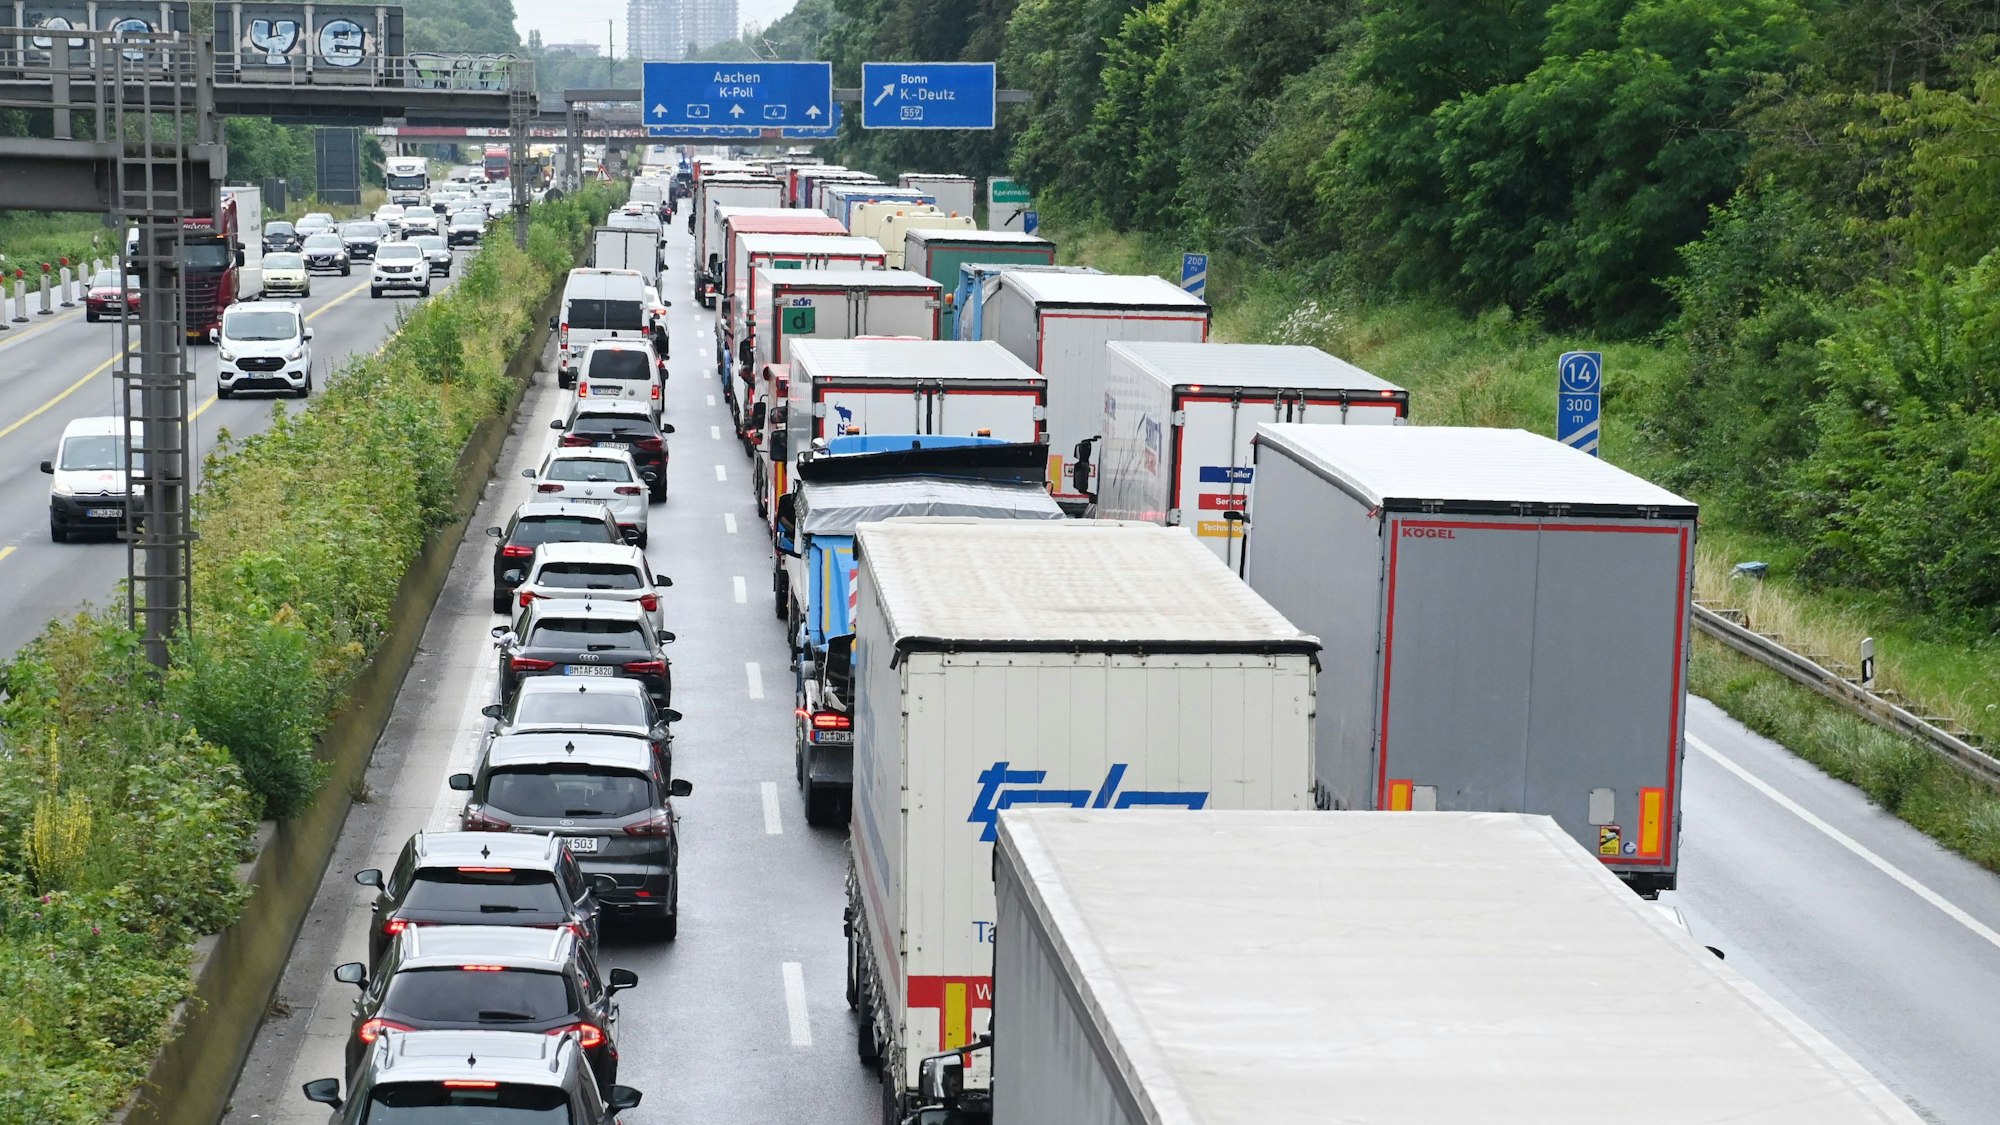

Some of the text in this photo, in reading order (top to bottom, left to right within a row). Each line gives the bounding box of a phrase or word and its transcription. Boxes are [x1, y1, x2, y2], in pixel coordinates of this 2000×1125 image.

[713, 71, 761, 83] Aachen
[901, 73, 928, 84] Bonn
[719, 86, 754, 98] K-Poll
[900, 88, 956, 100] K.-Deutz
[903, 108, 920, 118] 559
[1187, 257, 1203, 266] 200
[793, 312, 805, 330] d
[1568, 363, 1591, 383] 14
[1566, 398, 1592, 412] 300
[1572, 415, 1583, 423] m
[1225, 470, 1252, 479] Tailer
[1402, 527, 1456, 540] KÖGEL
[820, 732, 830, 741] AC
[836, 732, 846, 741] DH
[574, 839, 594, 849] 503
[972, 921, 997, 944] Tä
